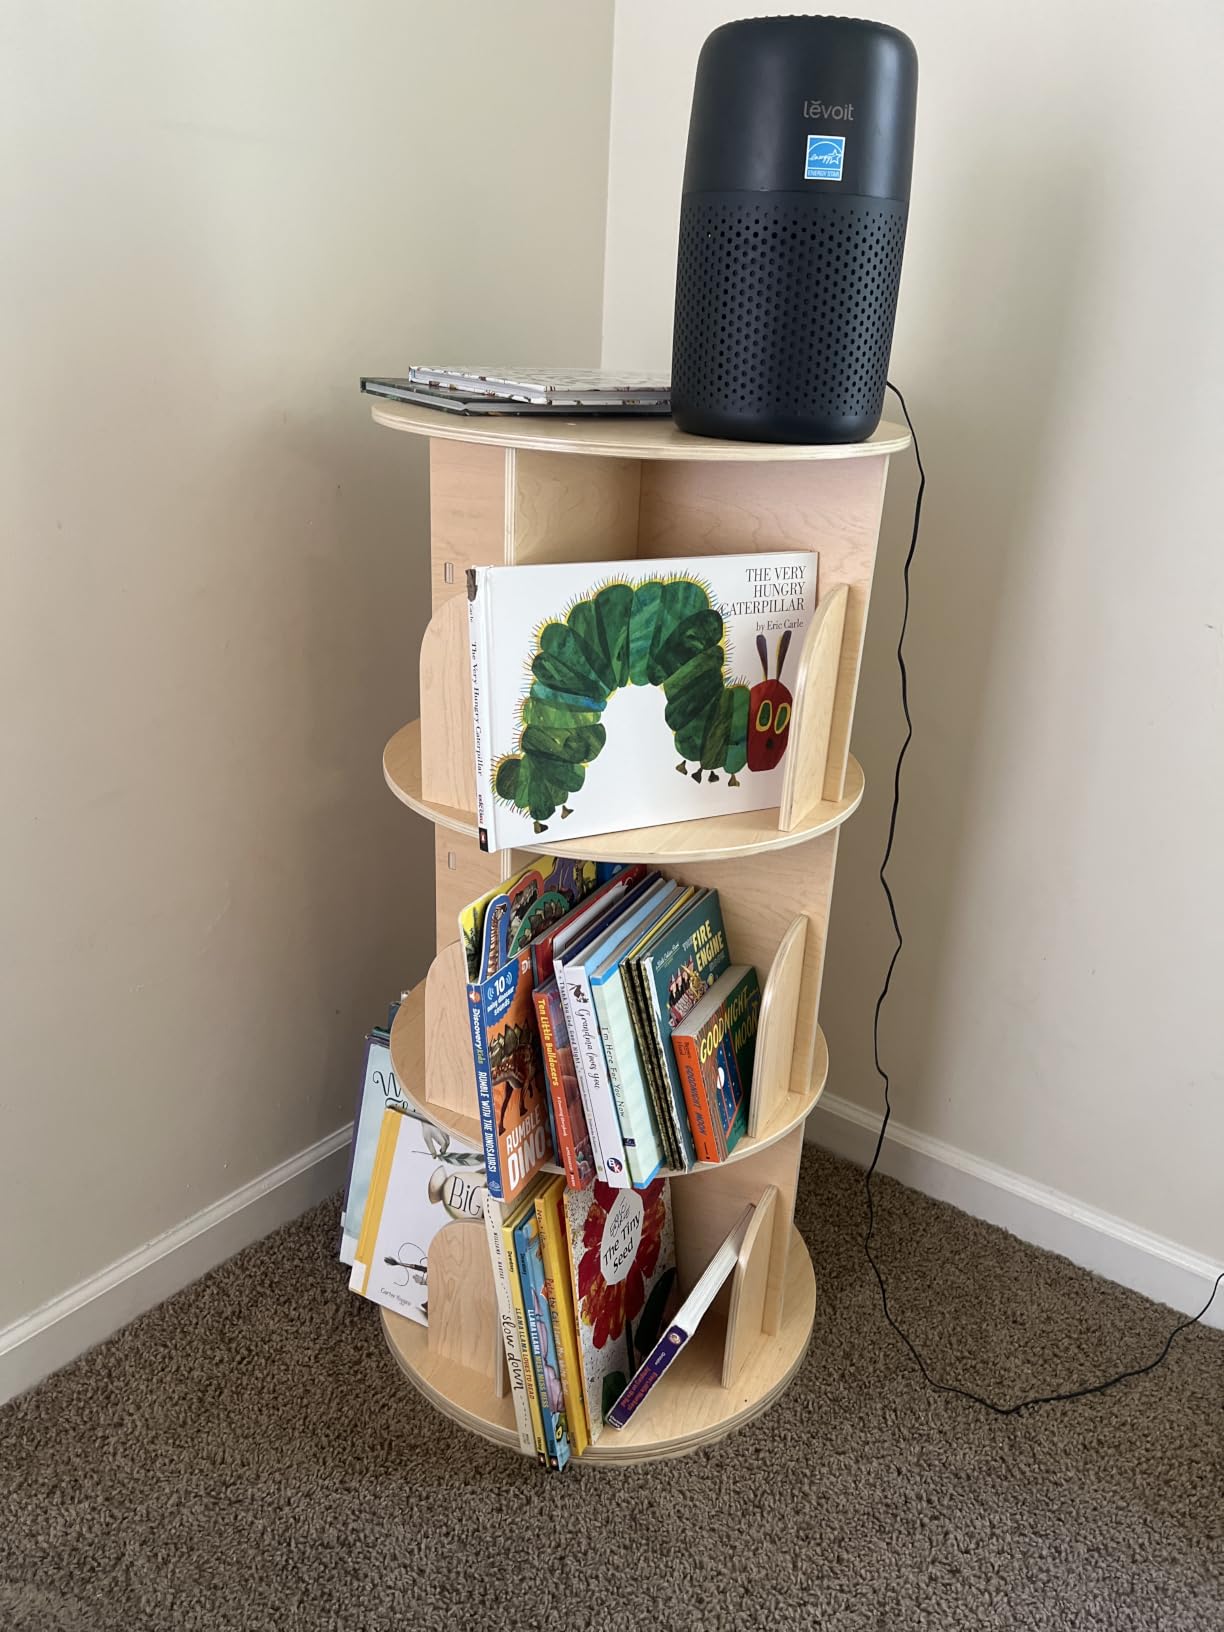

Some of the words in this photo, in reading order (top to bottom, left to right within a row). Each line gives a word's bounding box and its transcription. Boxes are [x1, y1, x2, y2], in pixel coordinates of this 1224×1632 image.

[745, 567, 771, 582] THE
[774, 565, 807, 580] VERY
[754, 581, 806, 598] HUNGRY
[720, 597, 805, 616] CATERPILLAR
[756, 621, 765, 633] by
[767, 619, 782, 631] Eric
[783, 618, 804, 629] Carle
[473, 686, 481, 722] Hungry
[474, 726, 484, 776] Caterpillar
[692, 919, 712, 953] FIRE
[696, 930, 724, 972] ENGINE
[494, 975, 506, 996] 10
[538, 999, 546, 1015] Ten
[473, 1008, 482, 1050] Discovery
[541, 1016, 552, 1041] Little
[559, 982, 569, 1001] Thank
[564, 1001, 572, 1013] You
[572, 1043, 580, 1064] Night
[575, 1008, 596, 1050] Grandma
[601, 1027, 609, 1041] I'm
[700, 985, 748, 1064] GOODNIGHT
[546, 1042, 559, 1086] Bulldozers
[606, 1044, 614, 1064] Here
[478, 1071, 489, 1098] RUMBLE
[610, 1067, 618, 1081] For
[613, 1084, 624, 1098] You
[685, 1064, 702, 1111] GOODNIGHT
[695, 1112, 707, 1136] MOON
[481, 1100, 491, 1120] WITH
[617, 1101, 625, 1118] Now
[483, 1120, 493, 1133] THE
[506, 1103, 540, 1155] RUMBLE
[603, 1239, 619, 1266] The
[621, 1210, 640, 1240] Tiny
[613, 1236, 633, 1274] Seed
[515, 1307, 524, 1331] LLAMA
[527, 1309, 537, 1331] LLAMA
[502, 1314, 516, 1349] slow
[519, 1331, 528, 1353] LLAMA
[531, 1332, 540, 1355] LLAMA
[507, 1352, 524, 1391] down
[523, 1353, 531, 1373] LOVES
[535, 1354, 543, 1373] MESS
[526, 1373, 532, 1382] TO
[538, 1373, 546, 1390] MESS
[527, 1382, 535, 1400] READ
[541, 1390, 549, 1408] MESS
